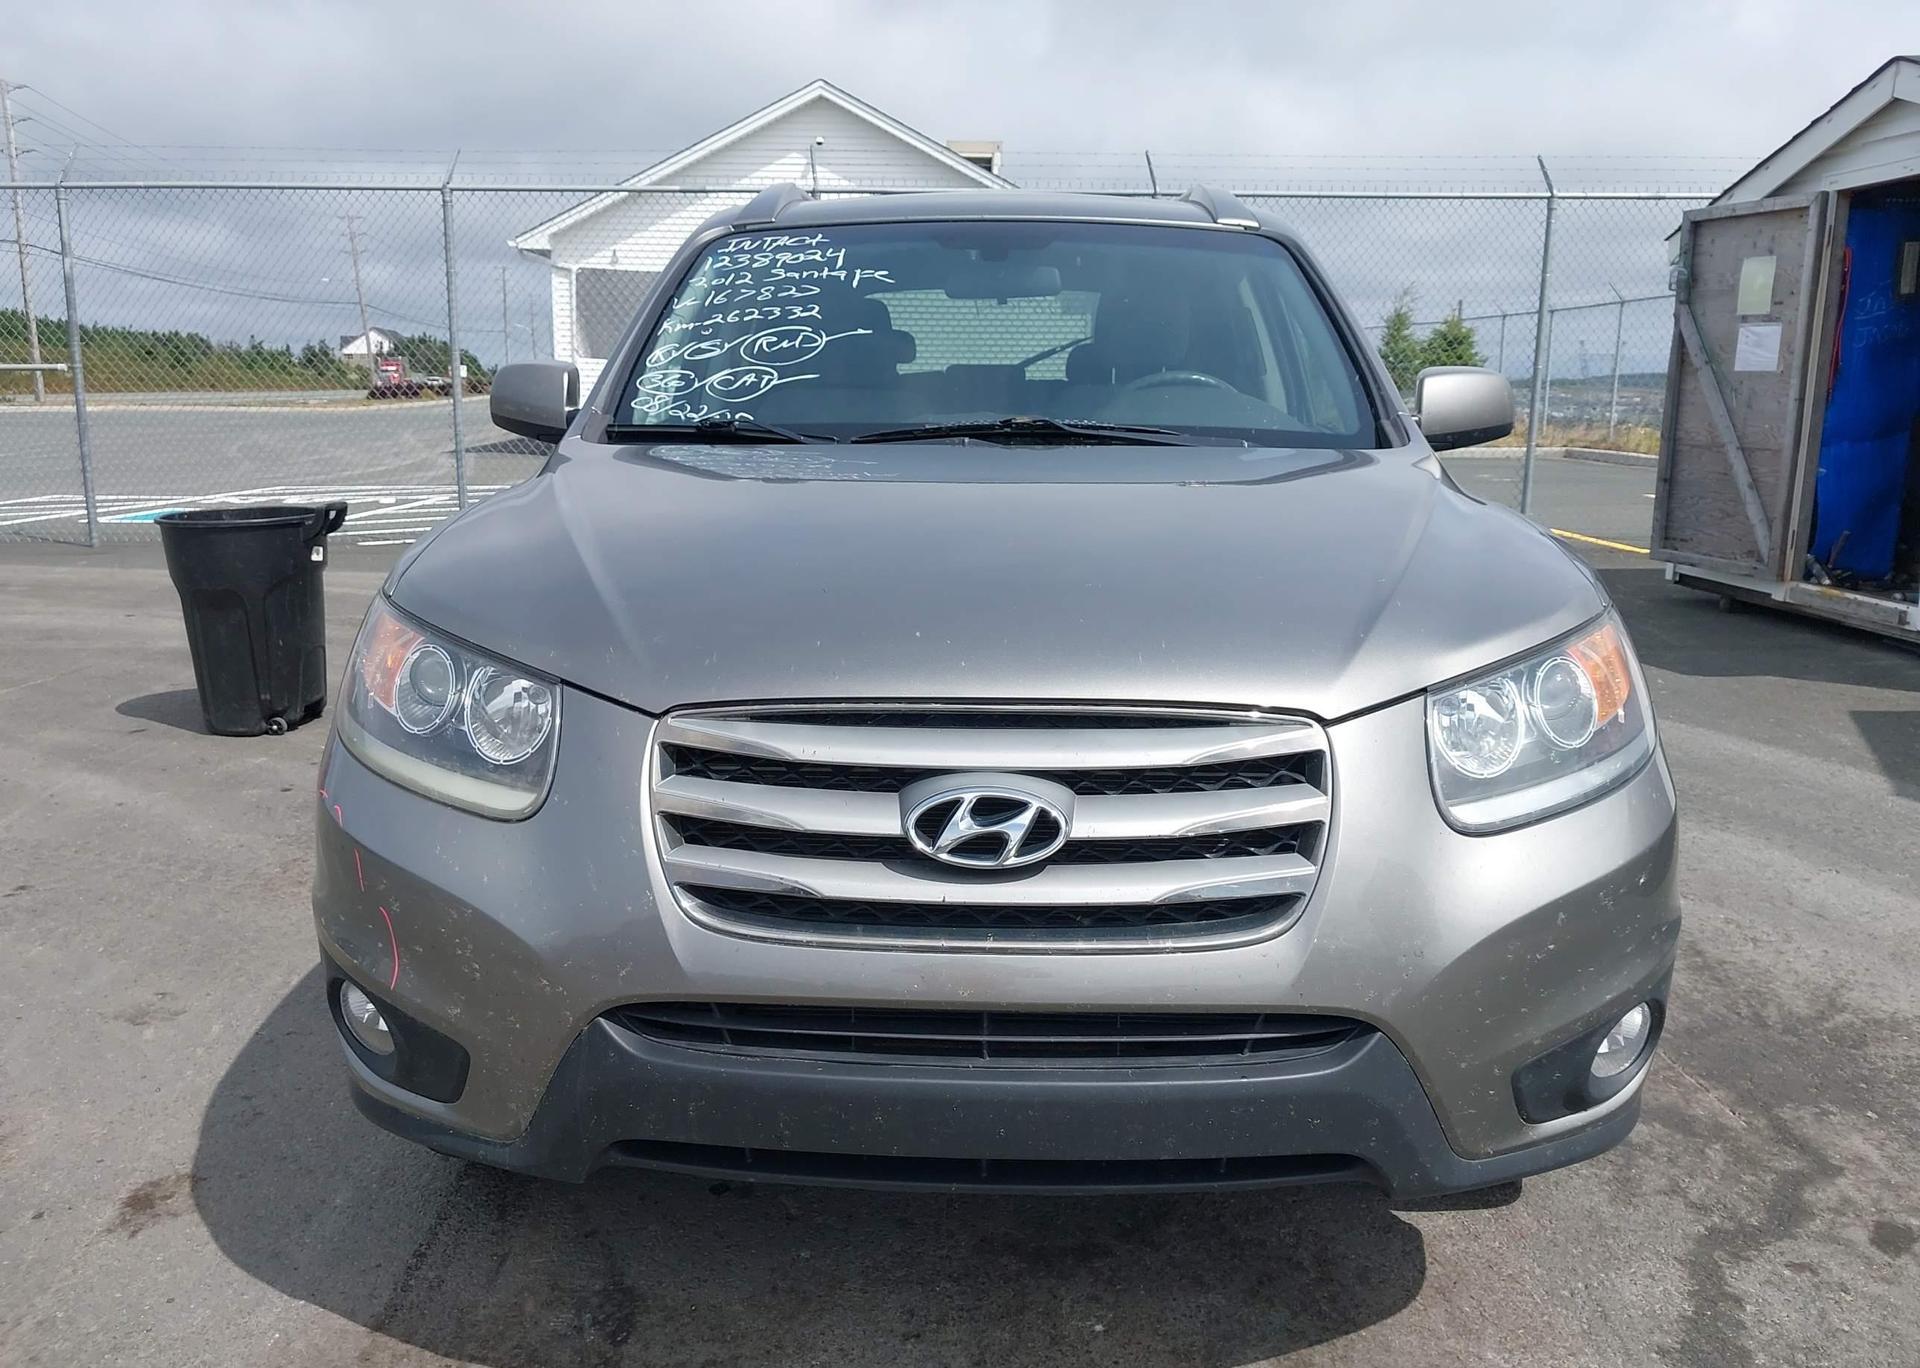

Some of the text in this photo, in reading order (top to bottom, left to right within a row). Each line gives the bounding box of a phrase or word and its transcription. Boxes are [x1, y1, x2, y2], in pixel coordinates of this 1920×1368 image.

[704, 248, 846, 271] 12389024
[688, 272, 754, 287] 2012
[763, 269, 848, 282] Santa
